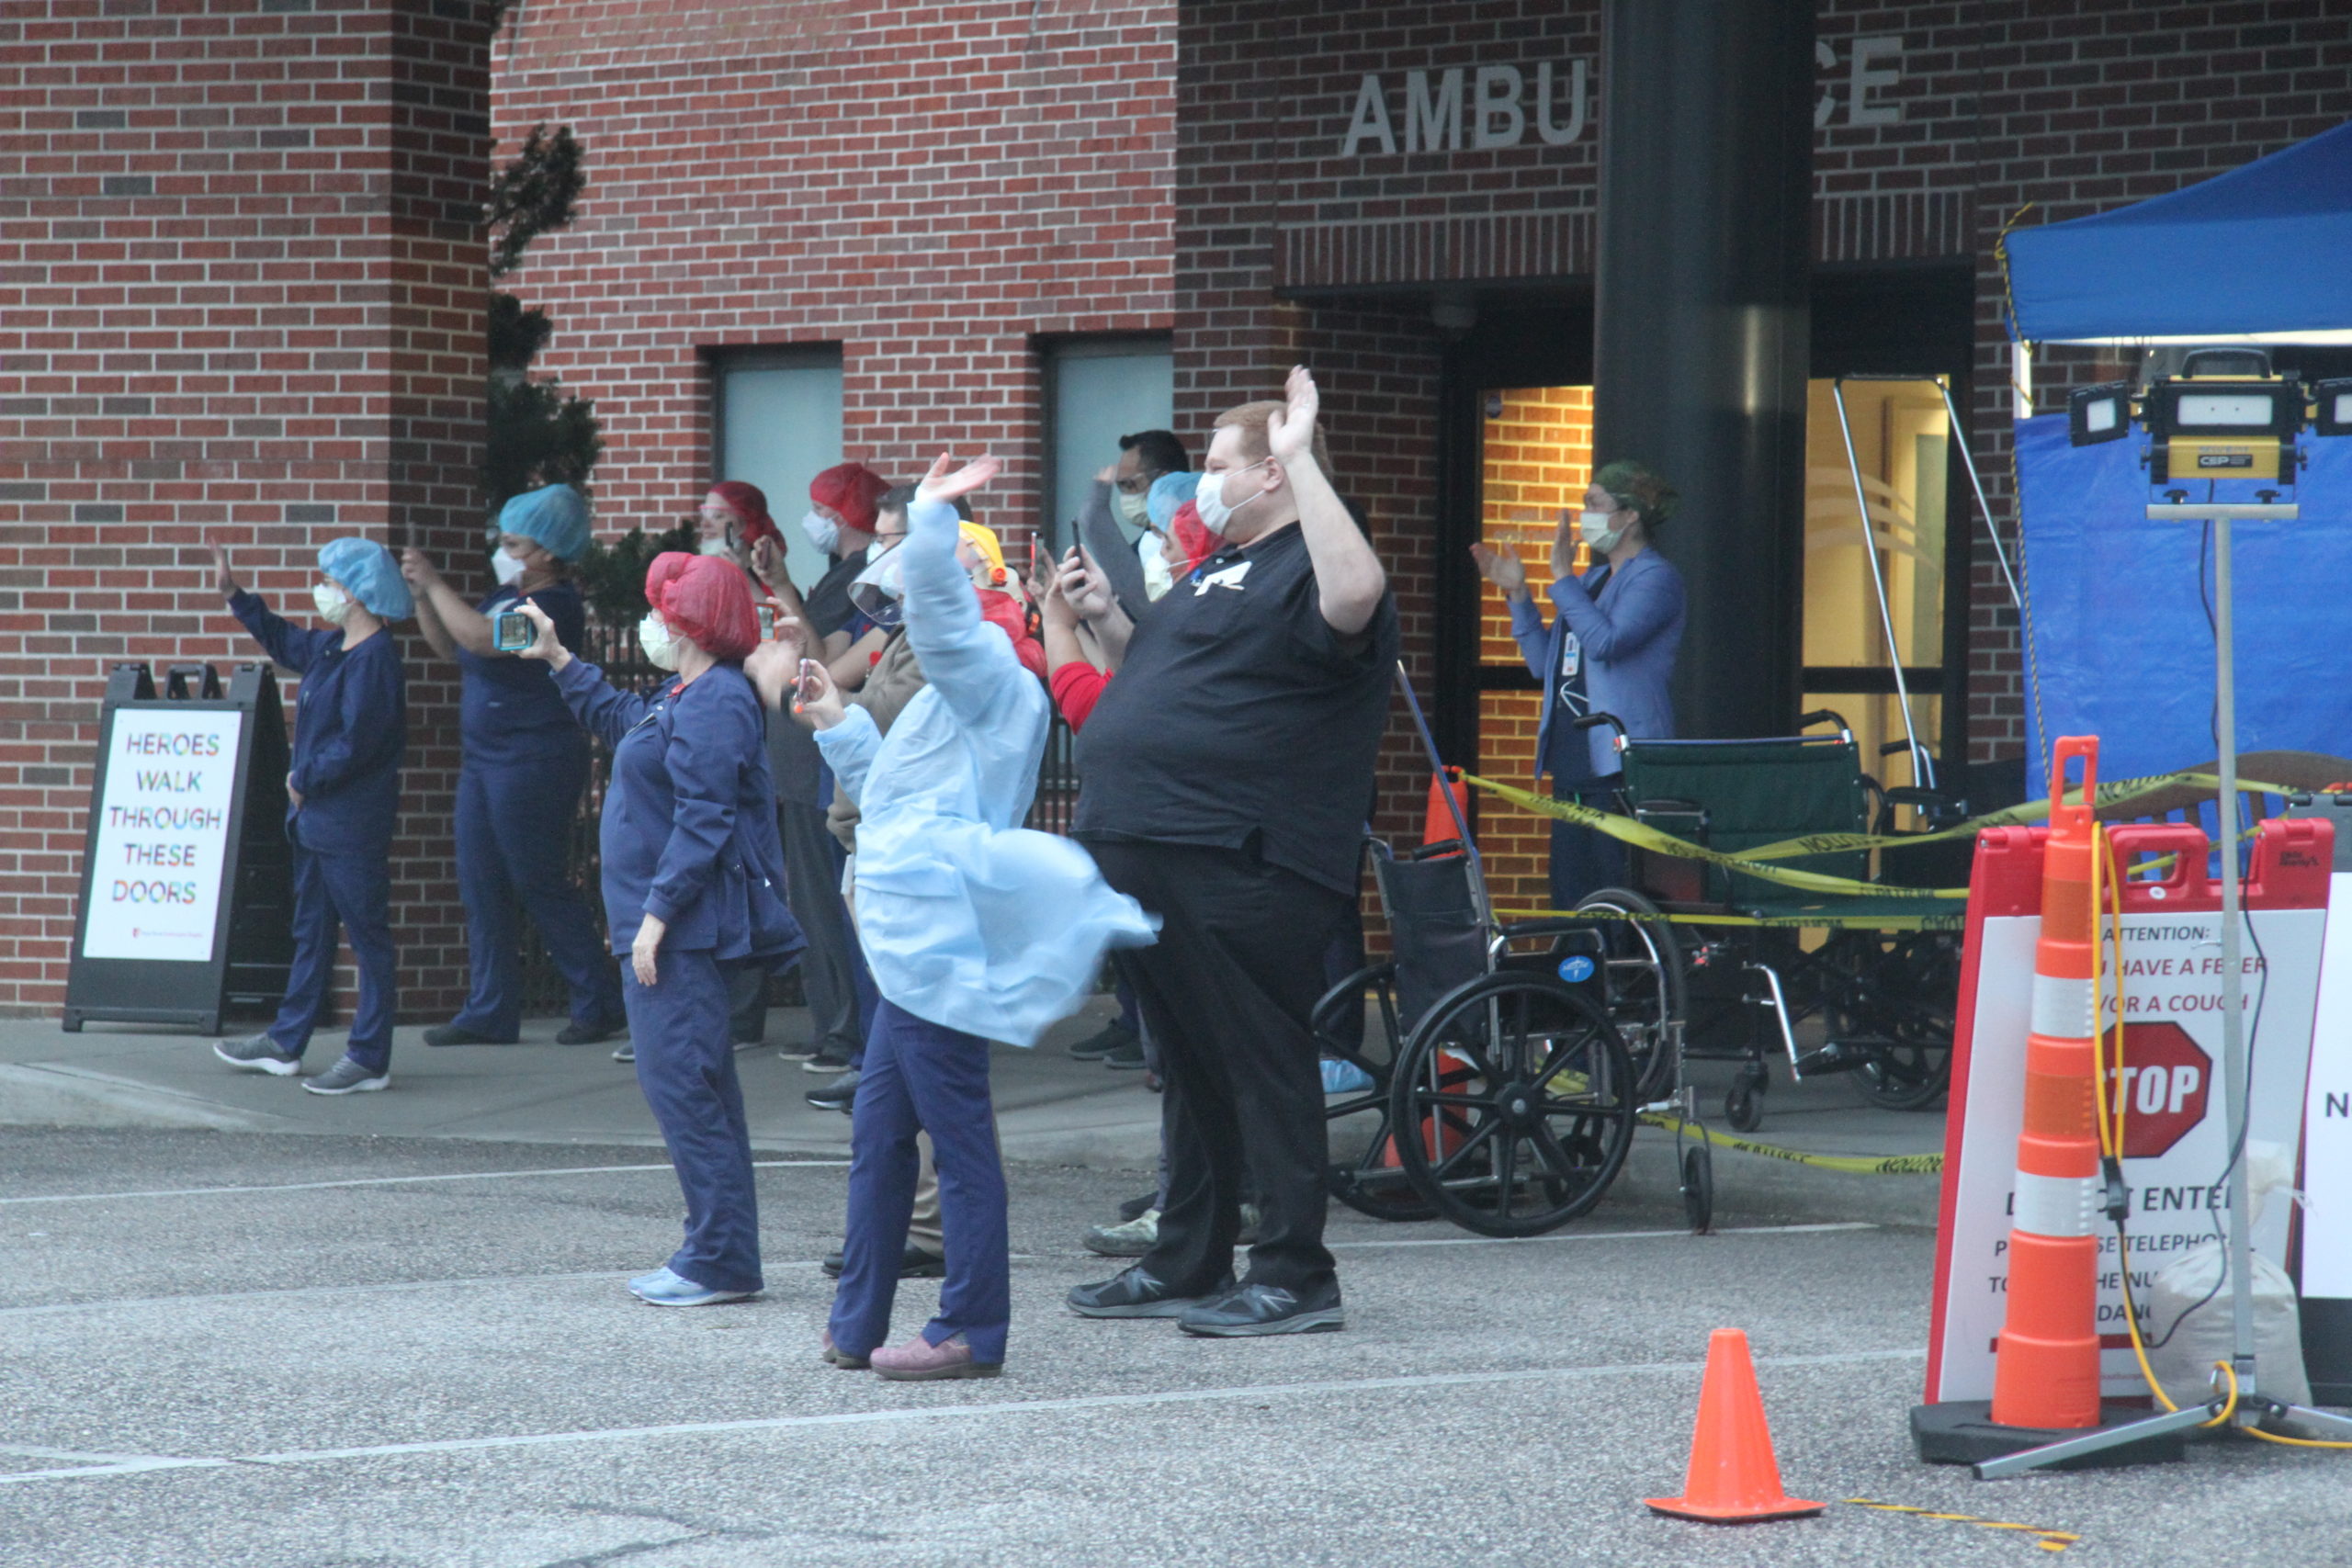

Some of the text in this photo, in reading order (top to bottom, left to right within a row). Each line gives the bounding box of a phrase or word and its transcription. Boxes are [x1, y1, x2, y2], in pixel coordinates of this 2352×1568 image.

[1342, 36, 1903, 157] AMBUE
[127, 733, 220, 756] HEROES
[137, 770, 201, 792] WALK
[109, 806, 221, 829] THROUGH
[124, 843, 197, 866] THESE
[112, 880, 196, 904] DOORS
[2178, 959, 2194, 975] A
[2201, 956, 2267, 975] FEER
[2146, 997, 2161, 1012] A
[2102, 1065, 2199, 1114] TOP
